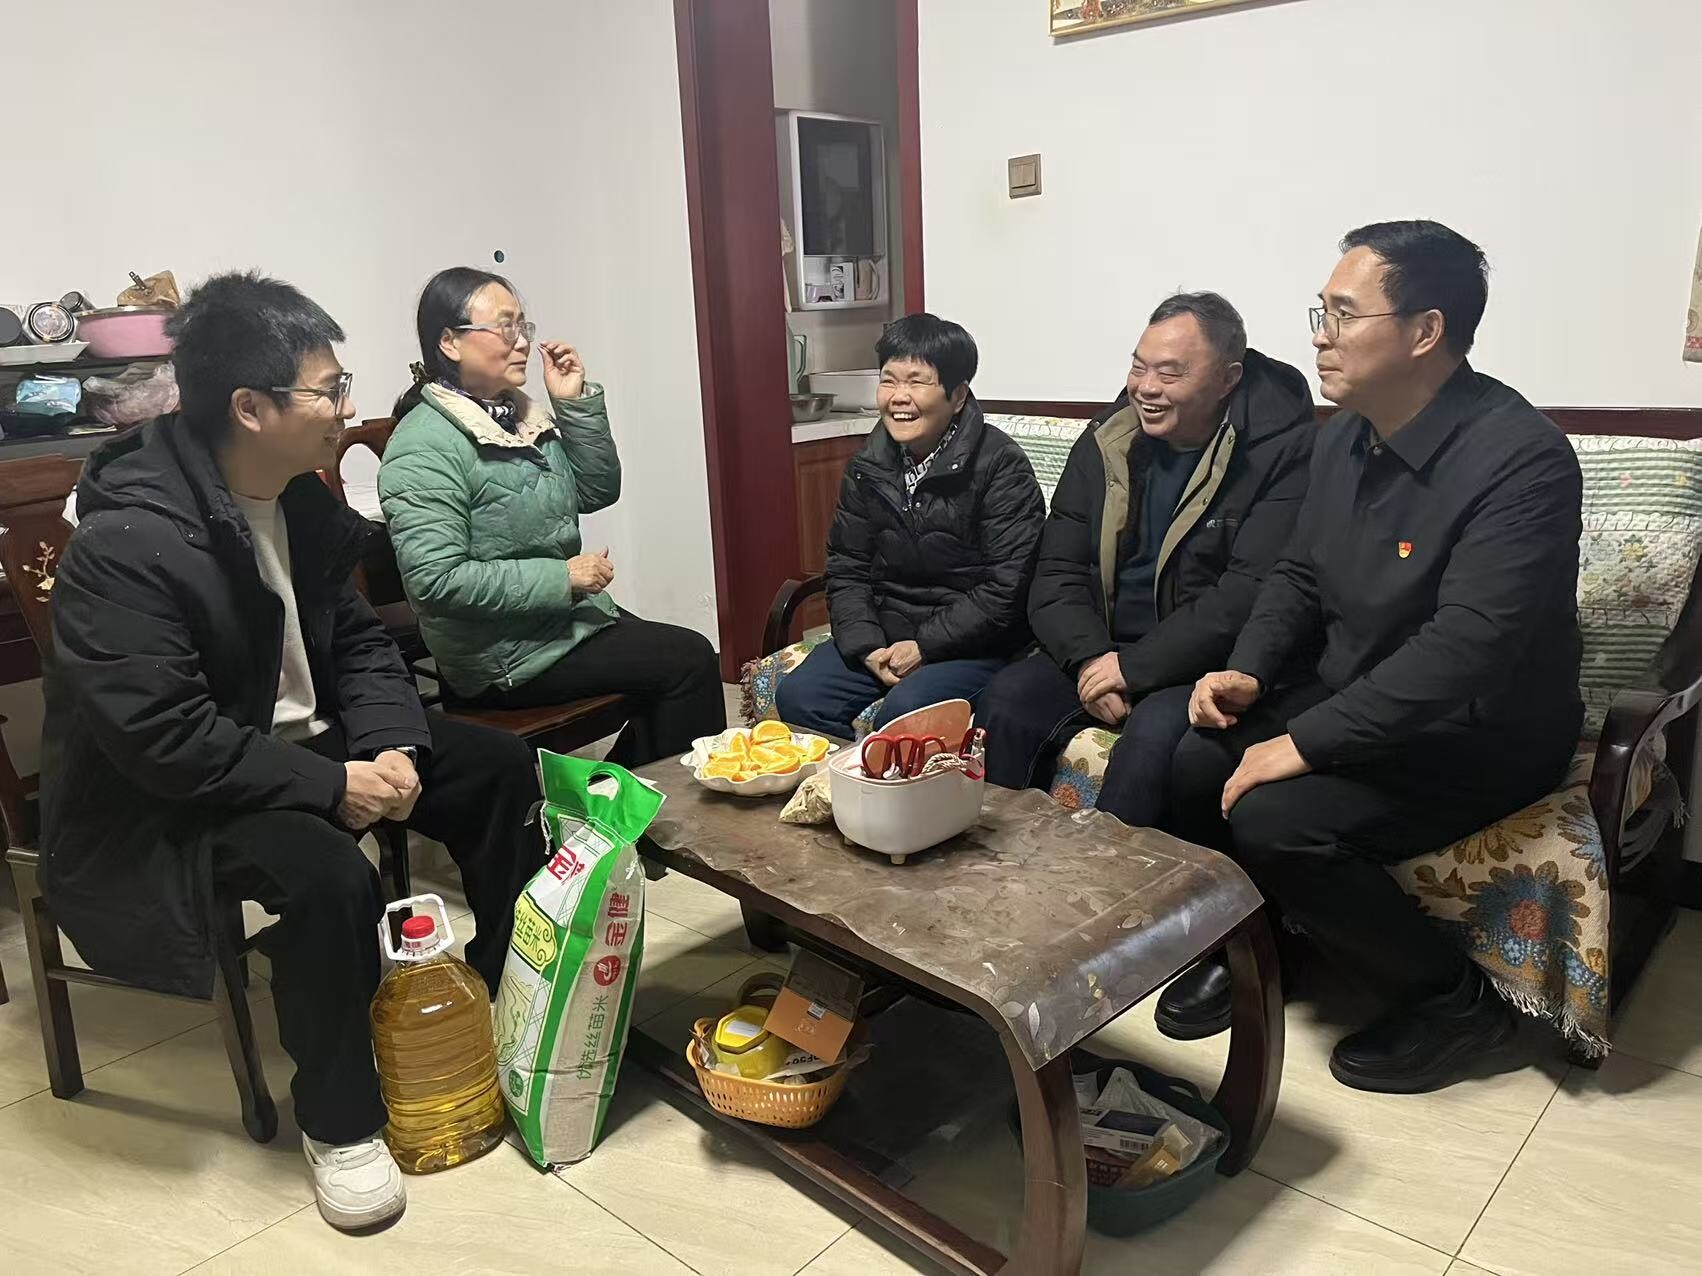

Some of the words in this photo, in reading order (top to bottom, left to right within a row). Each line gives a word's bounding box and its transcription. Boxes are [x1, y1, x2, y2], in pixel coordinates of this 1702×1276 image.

[546, 843, 585, 882] 金
[605, 892, 630, 947] 金健
[576, 995, 608, 1080] 优选丝苗米
